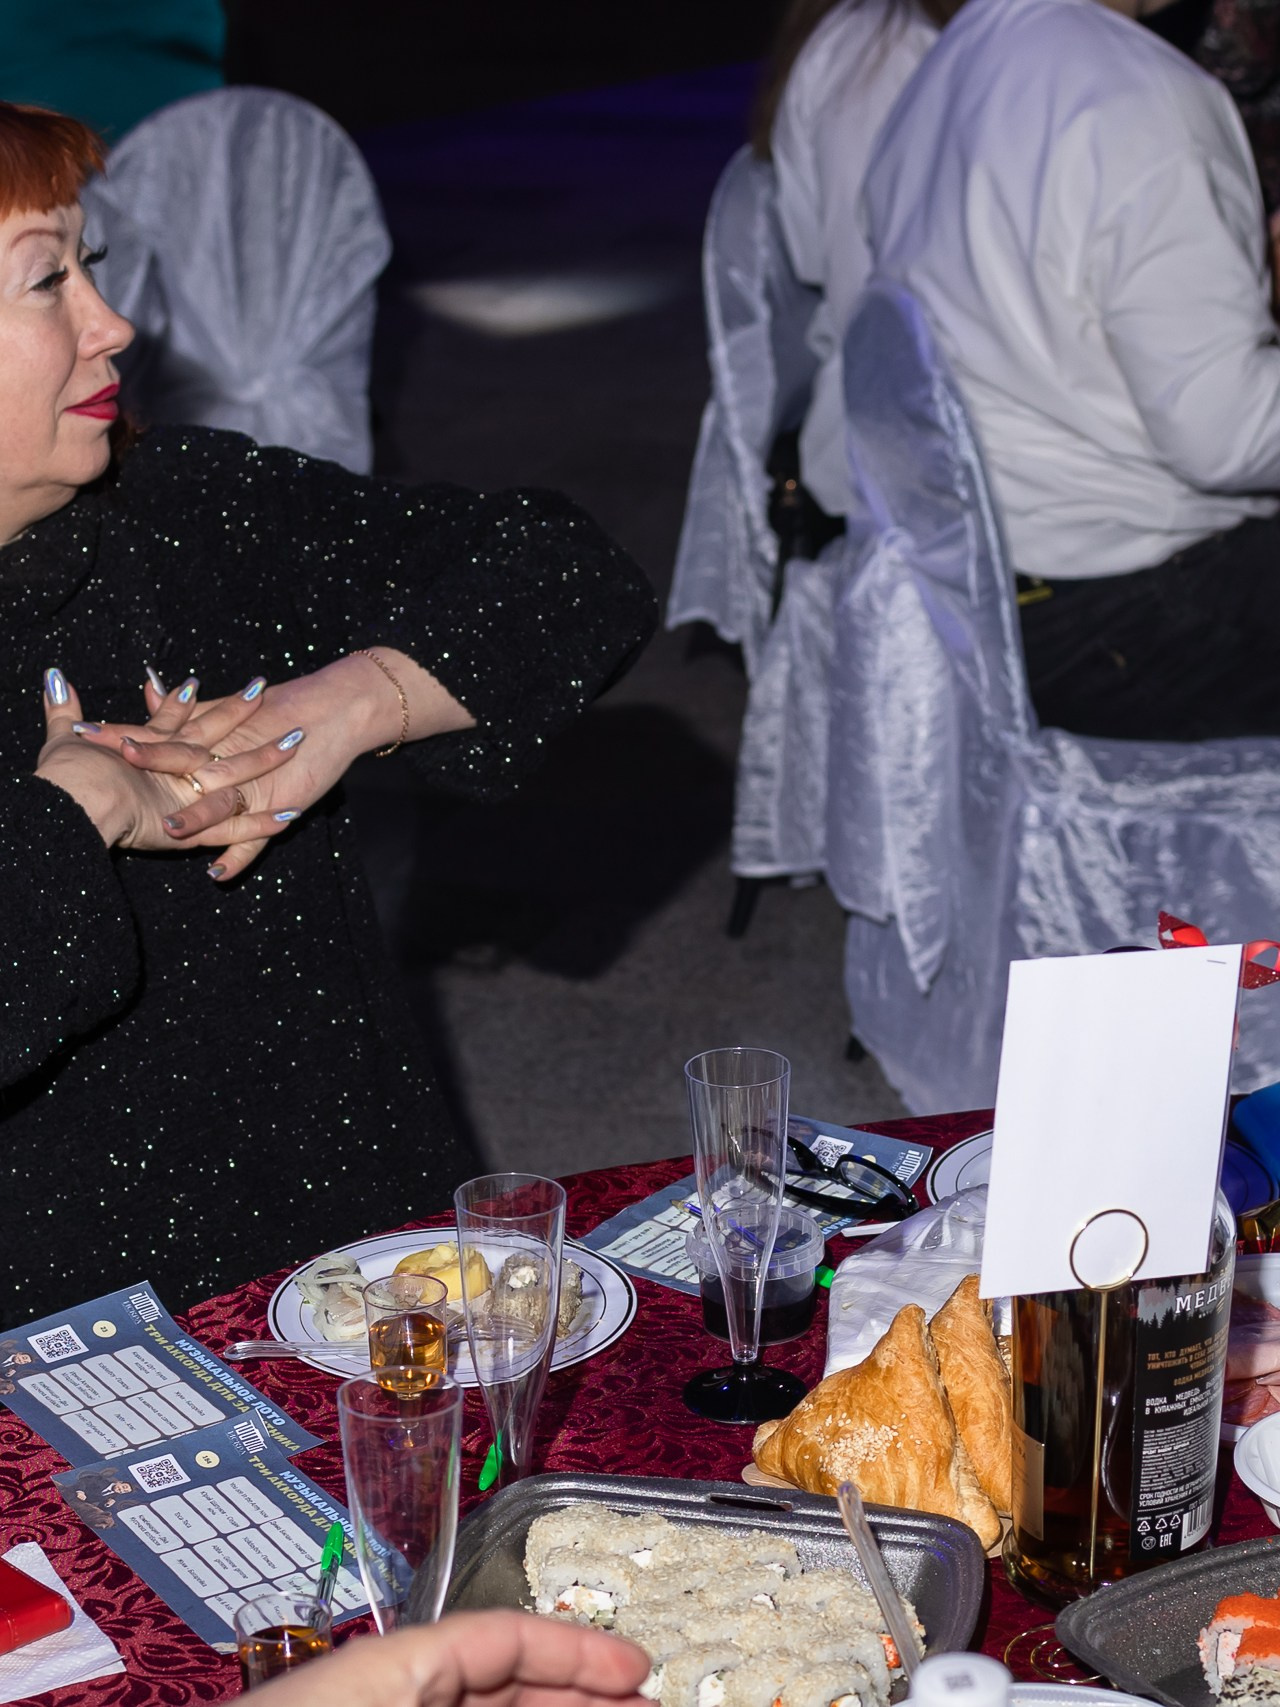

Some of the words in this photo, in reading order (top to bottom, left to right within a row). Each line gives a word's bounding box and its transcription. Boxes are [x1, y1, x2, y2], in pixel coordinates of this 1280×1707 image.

[1175, 1278, 1231, 1314] МЕДВ
[143, 1324, 169, 1345] ТРИ
[161, 1343, 215, 1383] АККОРДА
[206, 1380, 237, 1401] ДЛЯ
[173, 1338, 257, 1402] МУЗЫКАЛЬНОЕ
[249, 1400, 287, 1426] ЛОТО
[248, 1455, 274, 1476] ТРИ
[265, 1475, 319, 1518] АККОРДА
[279, 1470, 356, 1538] МУЗЫКАЛЬНОЕ
